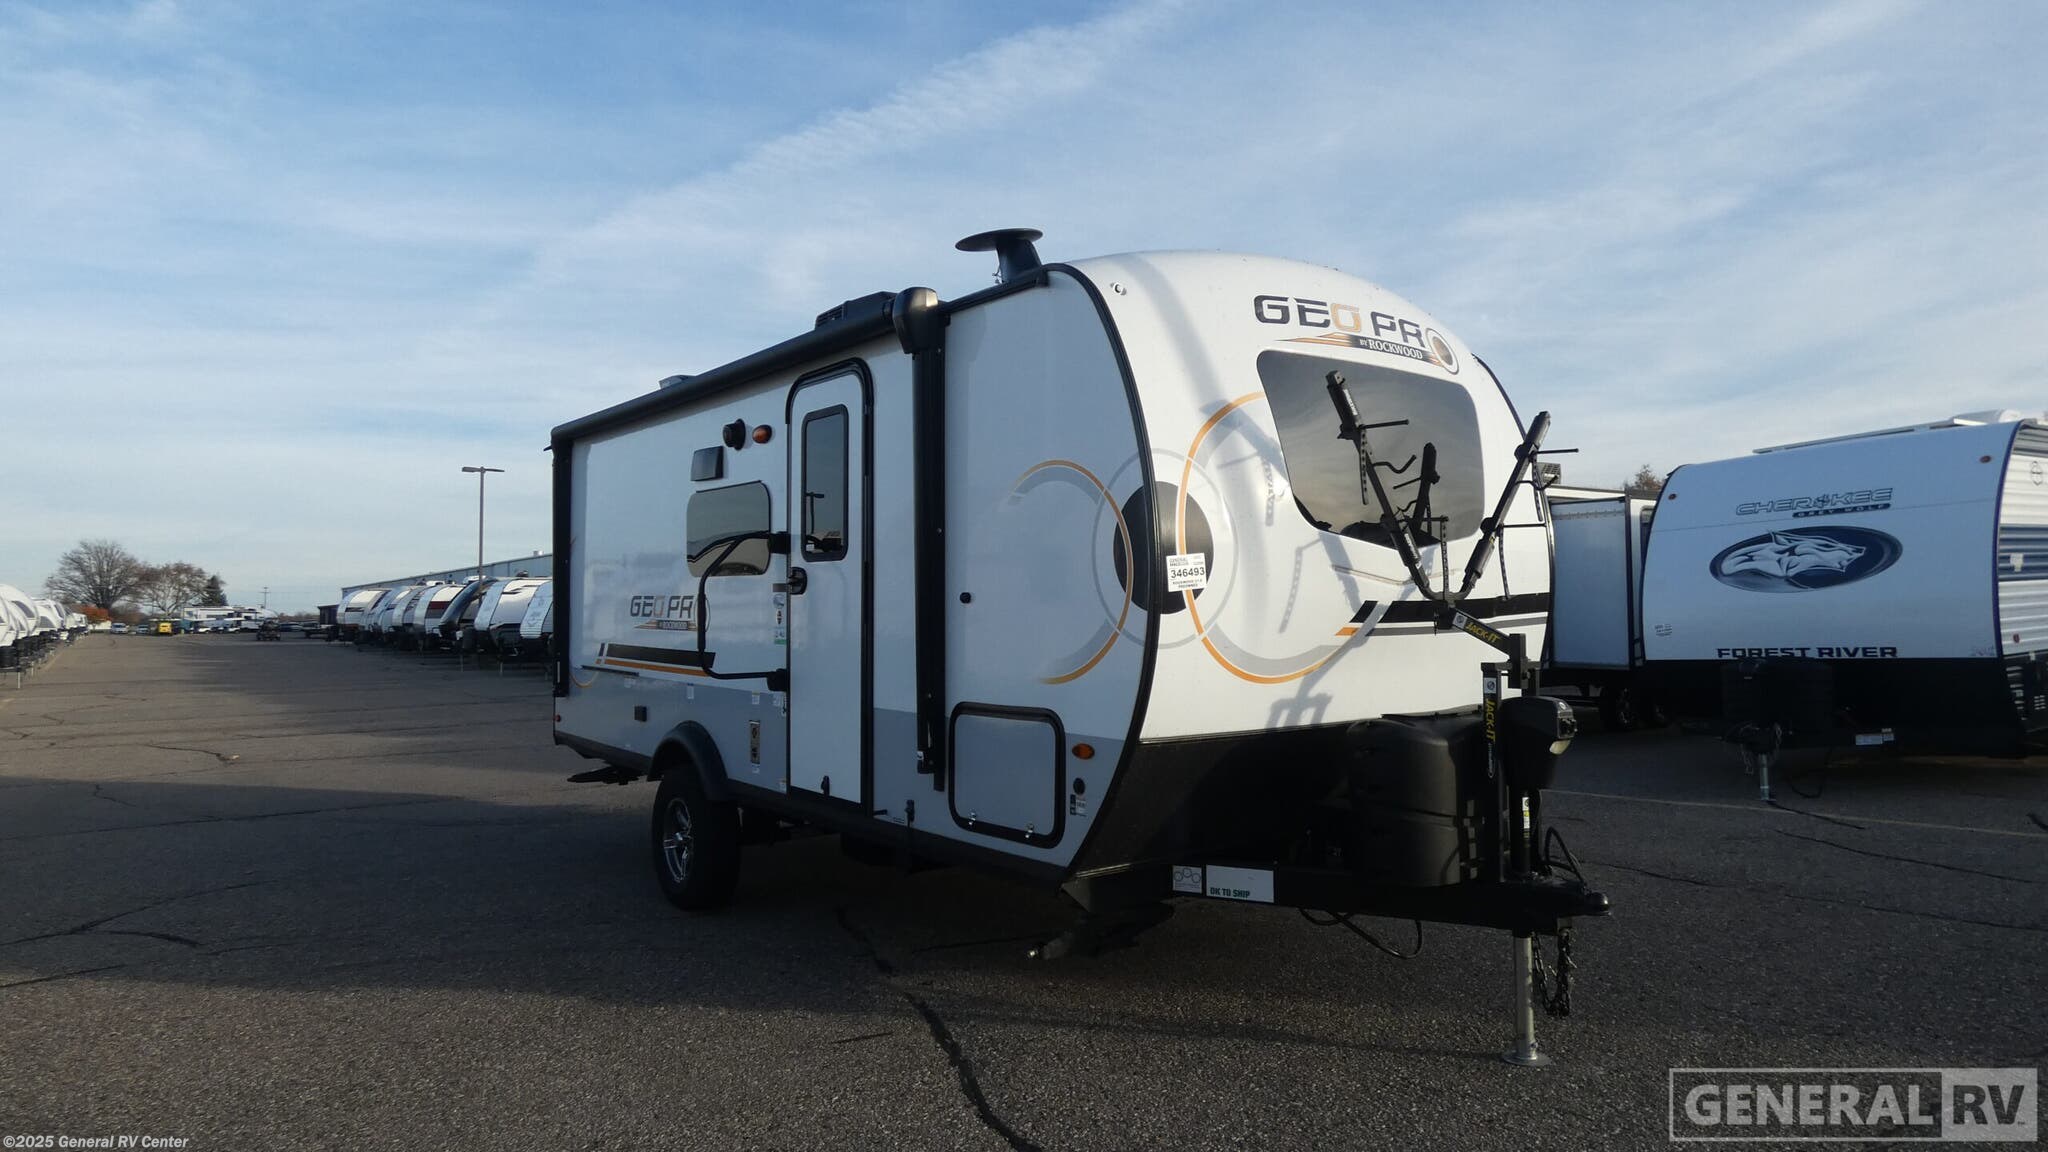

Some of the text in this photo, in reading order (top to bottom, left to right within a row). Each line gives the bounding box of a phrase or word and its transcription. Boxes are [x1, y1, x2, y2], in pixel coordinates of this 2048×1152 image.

[1253, 294, 1362, 333] GEO
[1359, 338, 1423, 360] BY ROCKWOOD
[1735, 487, 1894, 516] CHEROKEE
[1844, 503, 1887, 513] WOLF
[1170, 566, 1205, 579] 346493
[630, 595, 666, 618] GEO
[1465, 622, 1500, 643] JACK-IT
[1717, 646, 1898, 658] FOREST RIVER
[1485, 699, 1496, 742] JACK-IT
[1210, 887, 1250, 899] OK TO SHIP
